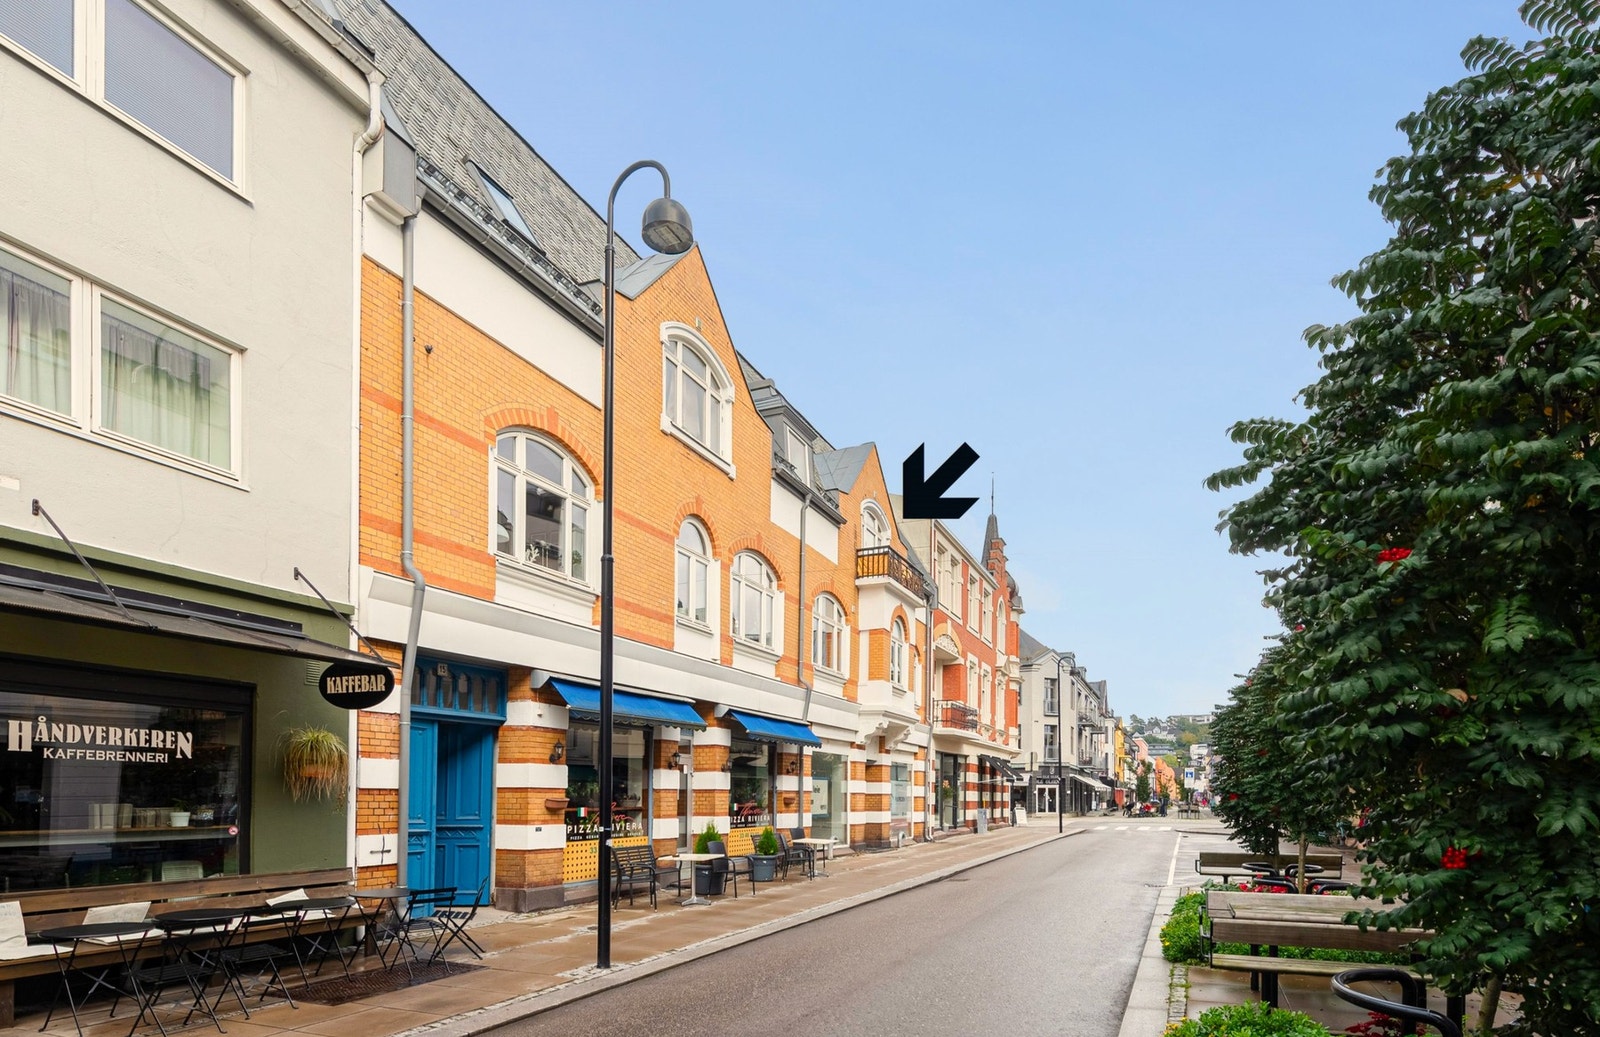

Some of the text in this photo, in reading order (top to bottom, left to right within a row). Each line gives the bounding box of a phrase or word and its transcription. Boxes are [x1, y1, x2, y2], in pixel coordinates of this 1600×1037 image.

[326, 674, 386, 694] KAFFEBAR
[7, 715, 193, 759] HÅNDVERKEREN
[43, 747, 168, 763] KAFFEBRENNERI
[730, 815, 745, 823] IZZA
[567, 822, 643, 834] PIZZA IVIERA
